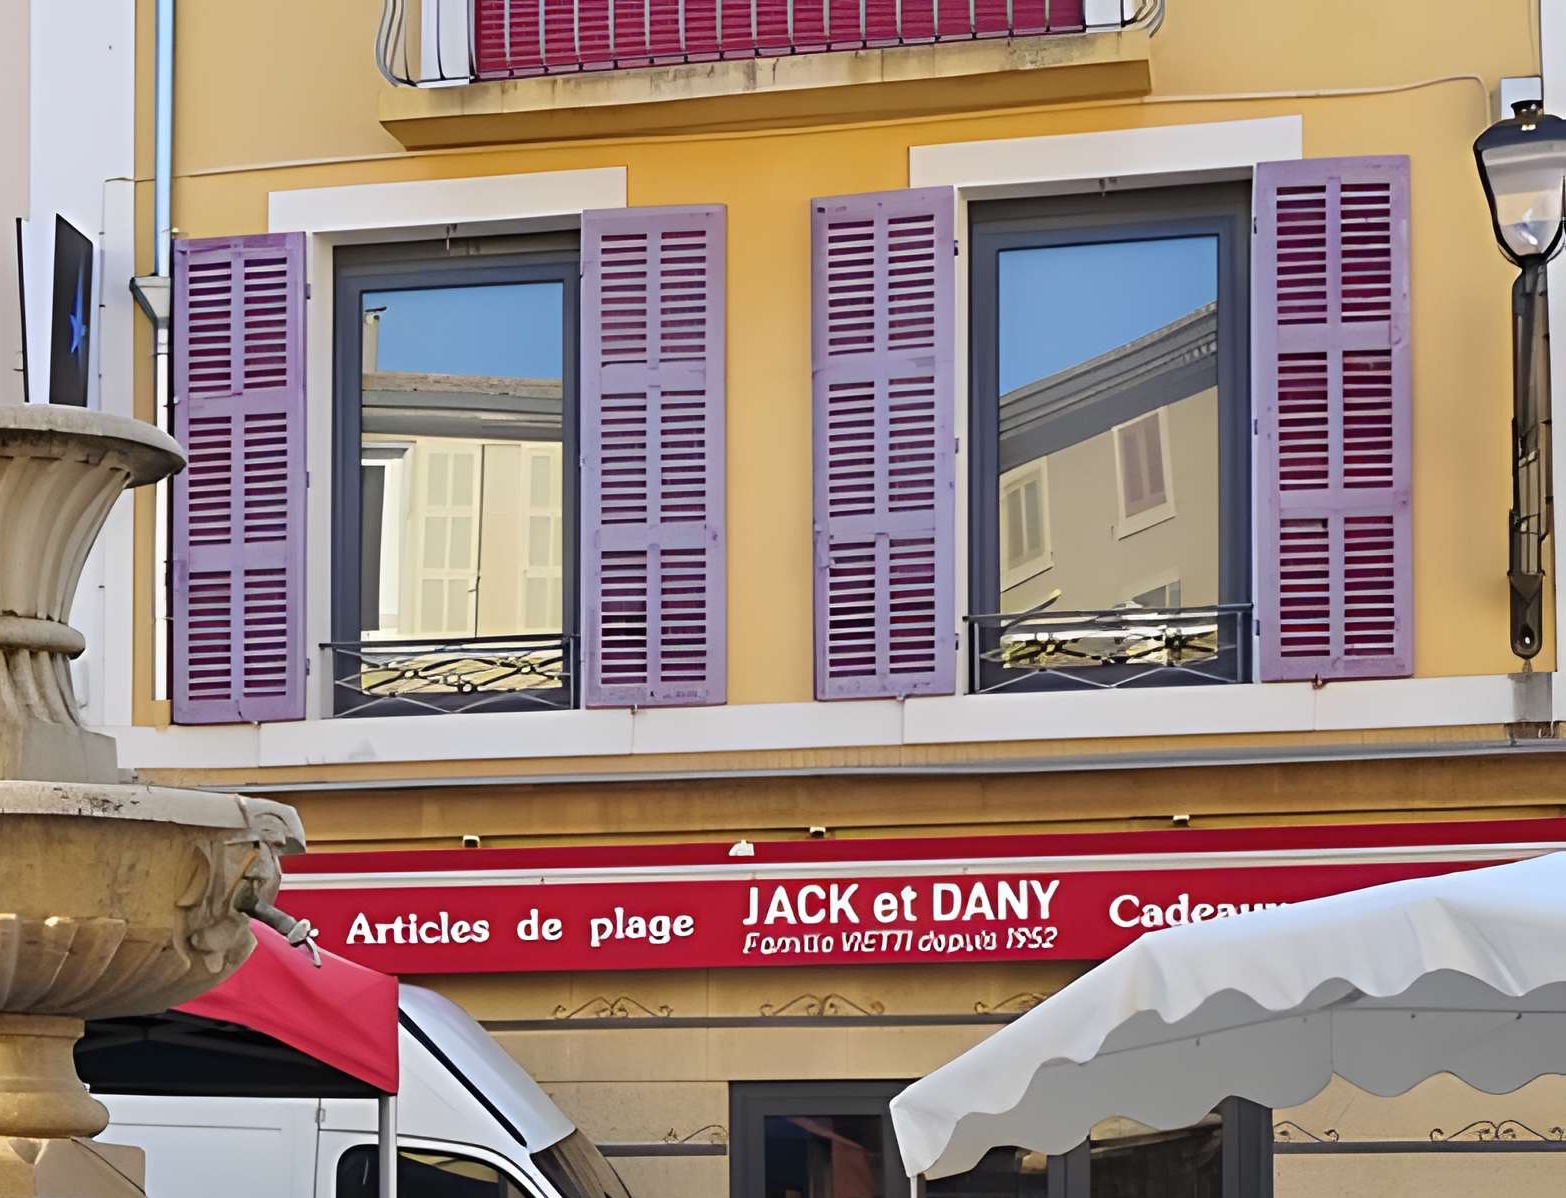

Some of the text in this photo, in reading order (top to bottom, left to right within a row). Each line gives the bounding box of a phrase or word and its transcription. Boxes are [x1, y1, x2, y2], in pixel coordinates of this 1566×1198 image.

[742, 879, 1061, 926] JACK et DANY
[1108, 892, 1288, 928] Cadea
[346, 907, 695, 948] Articles de plage
